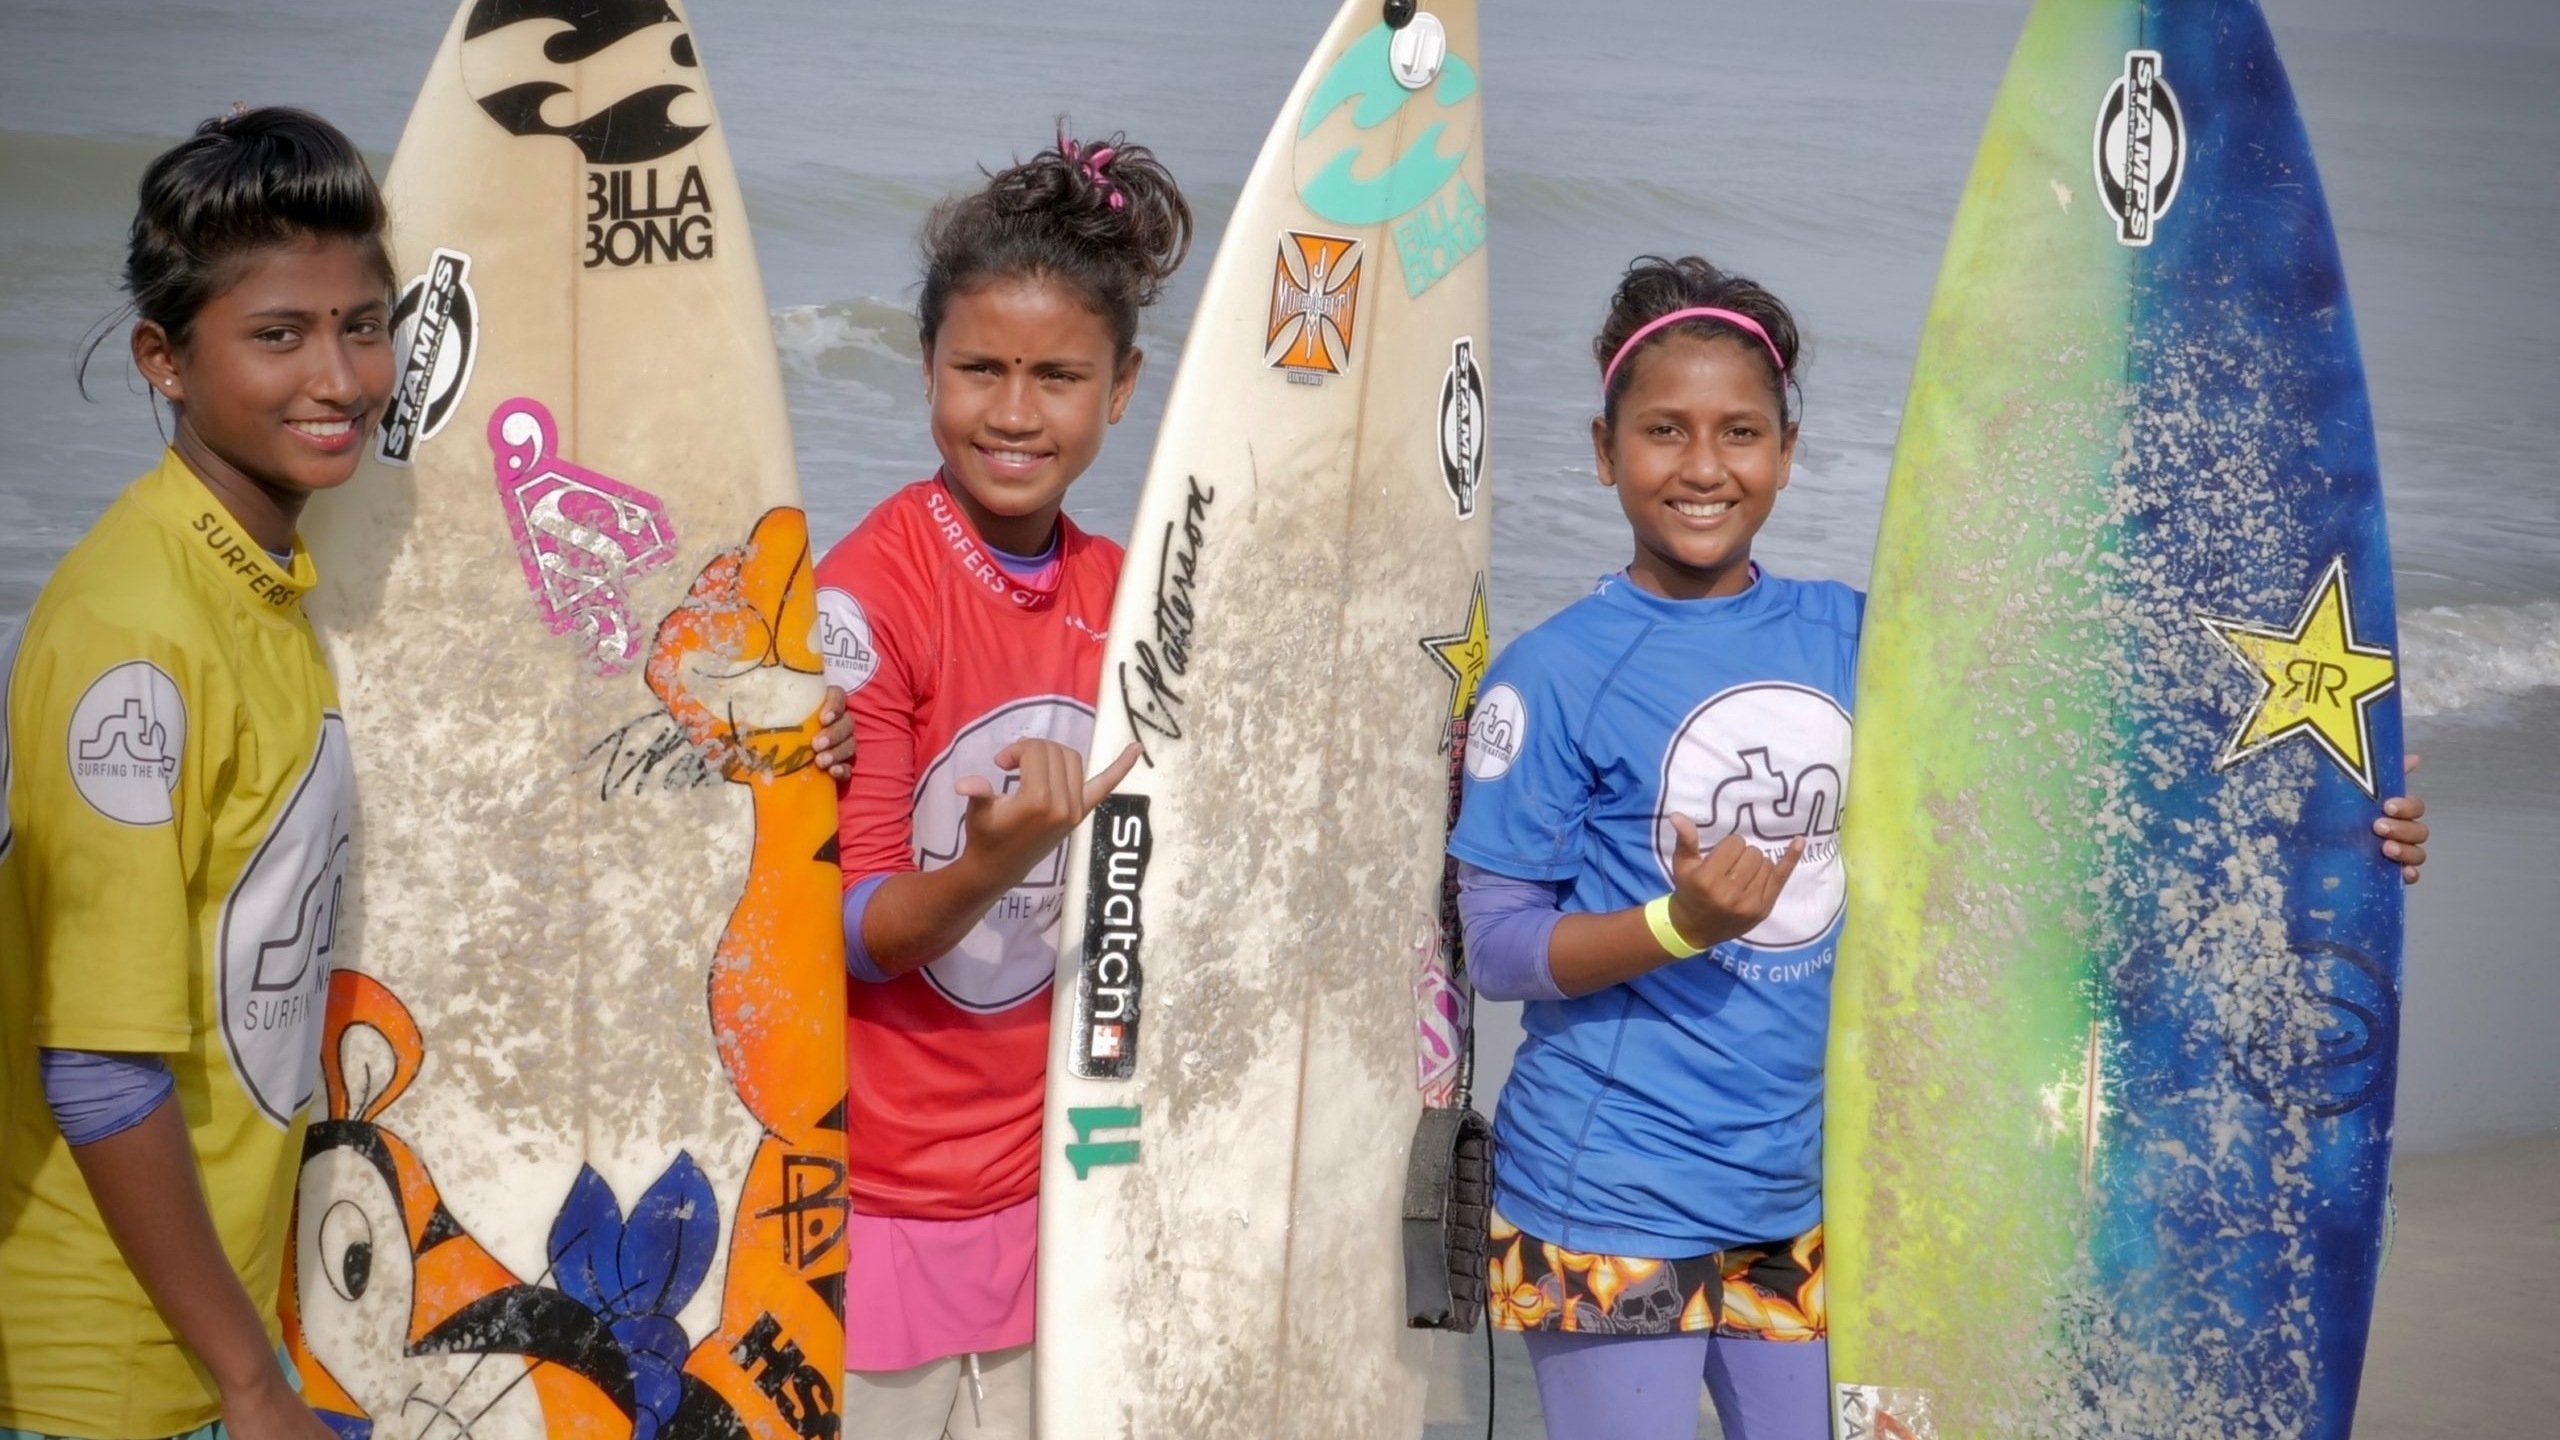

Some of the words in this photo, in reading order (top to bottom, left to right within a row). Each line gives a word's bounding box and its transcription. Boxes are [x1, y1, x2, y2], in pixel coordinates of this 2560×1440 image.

[2131, 60, 2153, 238] STAMPS
[586, 165, 712, 222] BILLA
[583, 215, 713, 269] BONG
[388, 259, 454, 456] STAMPS
[1459, 345, 1472, 511] STAMPS
[192, 512, 295, 606] SURFERS
[927, 493, 1009, 594] SURFERS
[835, 659, 870, 673] NATIONS
[78, 762, 127, 777] SURFING
[132, 764, 153, 779] THE
[998, 896, 1032, 920] THE
[1094, 815, 1142, 1020] swatch
[1768, 946, 1833, 983] GIVING
